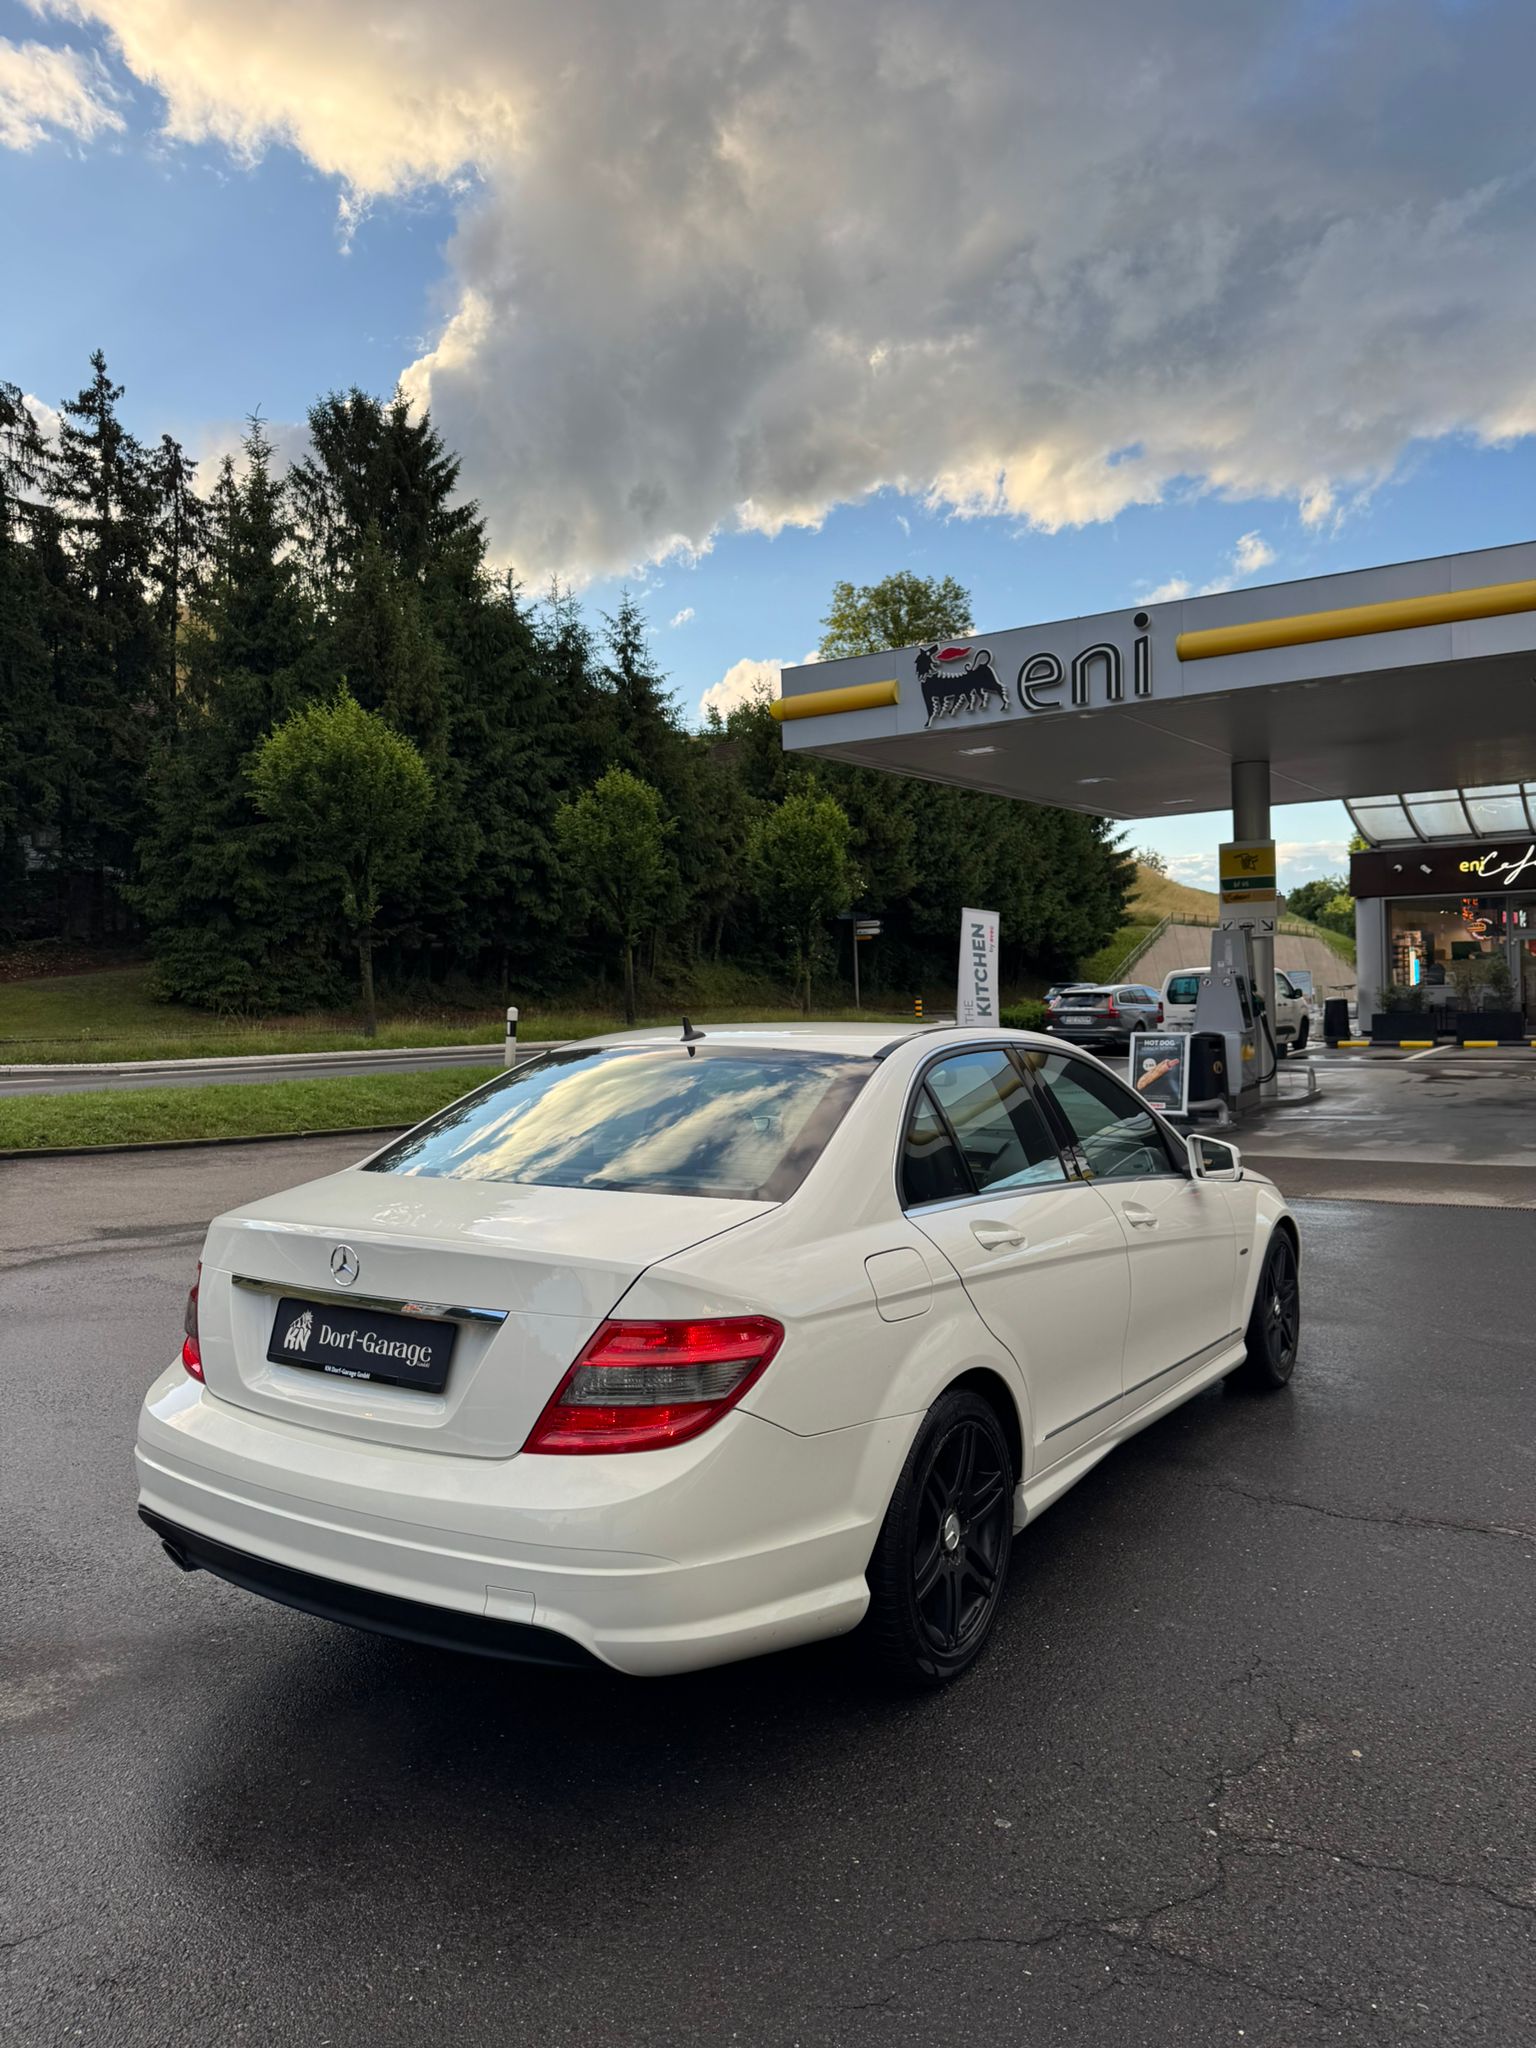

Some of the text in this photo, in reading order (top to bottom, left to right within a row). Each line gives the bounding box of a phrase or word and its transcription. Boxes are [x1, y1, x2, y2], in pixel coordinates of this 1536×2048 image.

[1017, 611, 1152, 712] eni
[971, 923, 992, 1017] KITCHEN
[963, 1000, 975, 1024] THE
[284, 1327, 312, 1352] KN
[319, 1325, 433, 1367] Dorf-Garage
[331, 1366, 357, 1378] Dorf-Garage
[357, 1371, 371, 1379] GmbH
